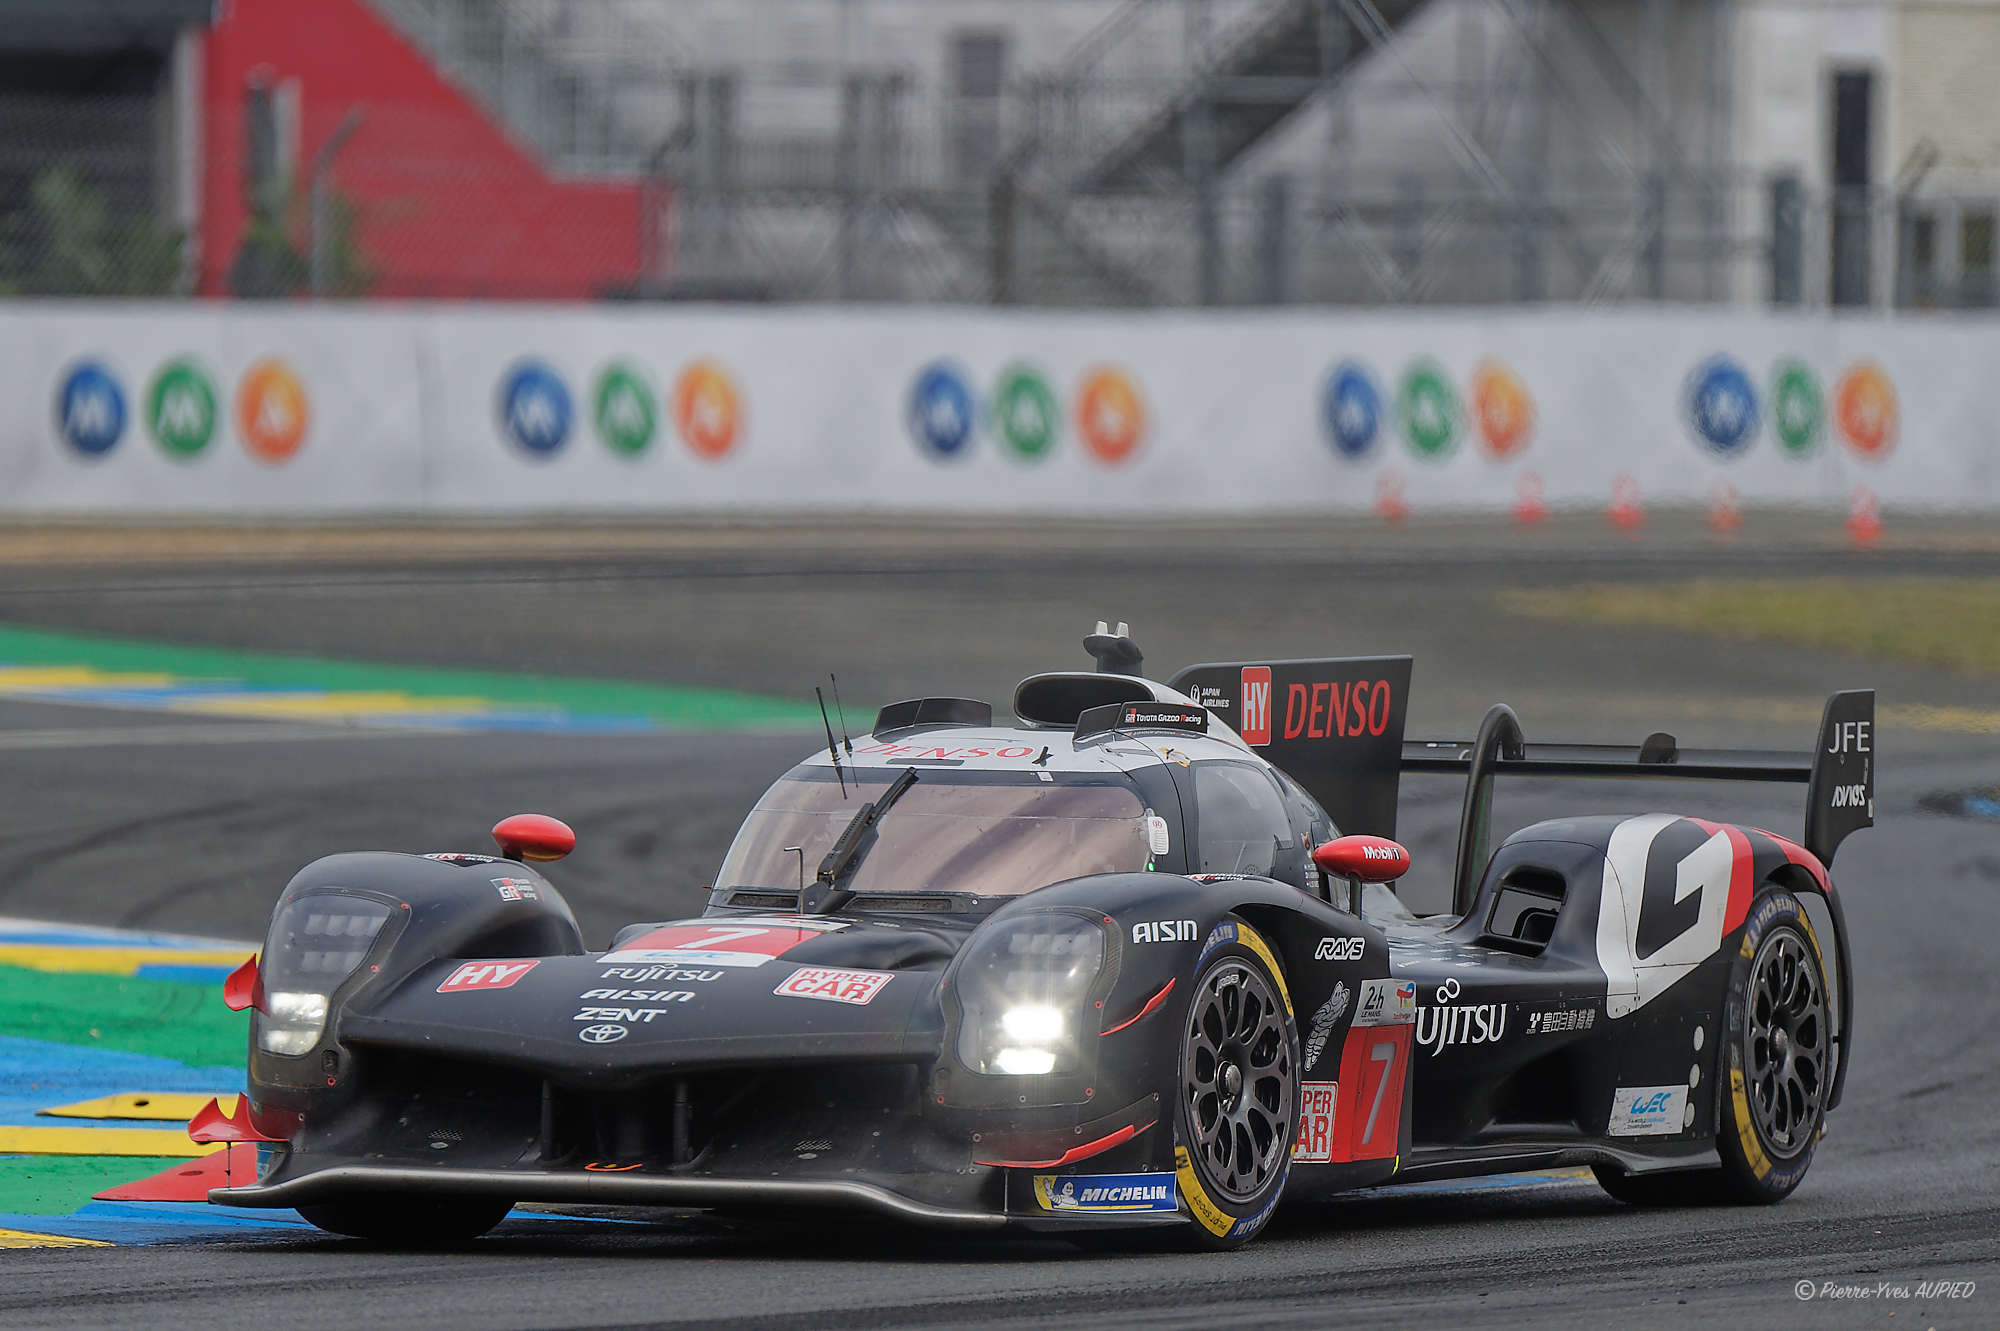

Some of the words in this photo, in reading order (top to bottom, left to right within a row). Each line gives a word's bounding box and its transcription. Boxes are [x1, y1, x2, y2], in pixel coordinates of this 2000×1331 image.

[1202, 687, 1221, 697] JAPAN
[1202, 698, 1230, 708] AIRLINES
[1243, 682, 1269, 730] HY
[1284, 680, 1391, 740] DENSO
[1180, 714, 1202, 725] Racing
[1828, 721, 1871, 754] JFE
[853, 742, 1034, 759] DENSO
[1362, 845, 1393, 860] Mobil
[673, 927, 771, 950] 7
[1132, 919, 1199, 944] AISIN
[1314, 936, 1366, 961] RAYS
[447, 964, 530, 986] HY
[600, 966, 725, 983] FUJITSU
[800, 970, 882, 985] HYPER
[579, 988, 697, 1002] AISIN
[787, 978, 873, 1000] CAR
[573, 1007, 668, 1023] ZENT
[1414, 1003, 1507, 1057] UJITSU
[1301, 1090, 1333, 1114] PER
[1361, 1042, 1397, 1146] 7
[1630, 1091, 1673, 1114] WEC
[1295, 1115, 1329, 1153] AR
[1080, 1185, 1168, 1202] MICHELIN
